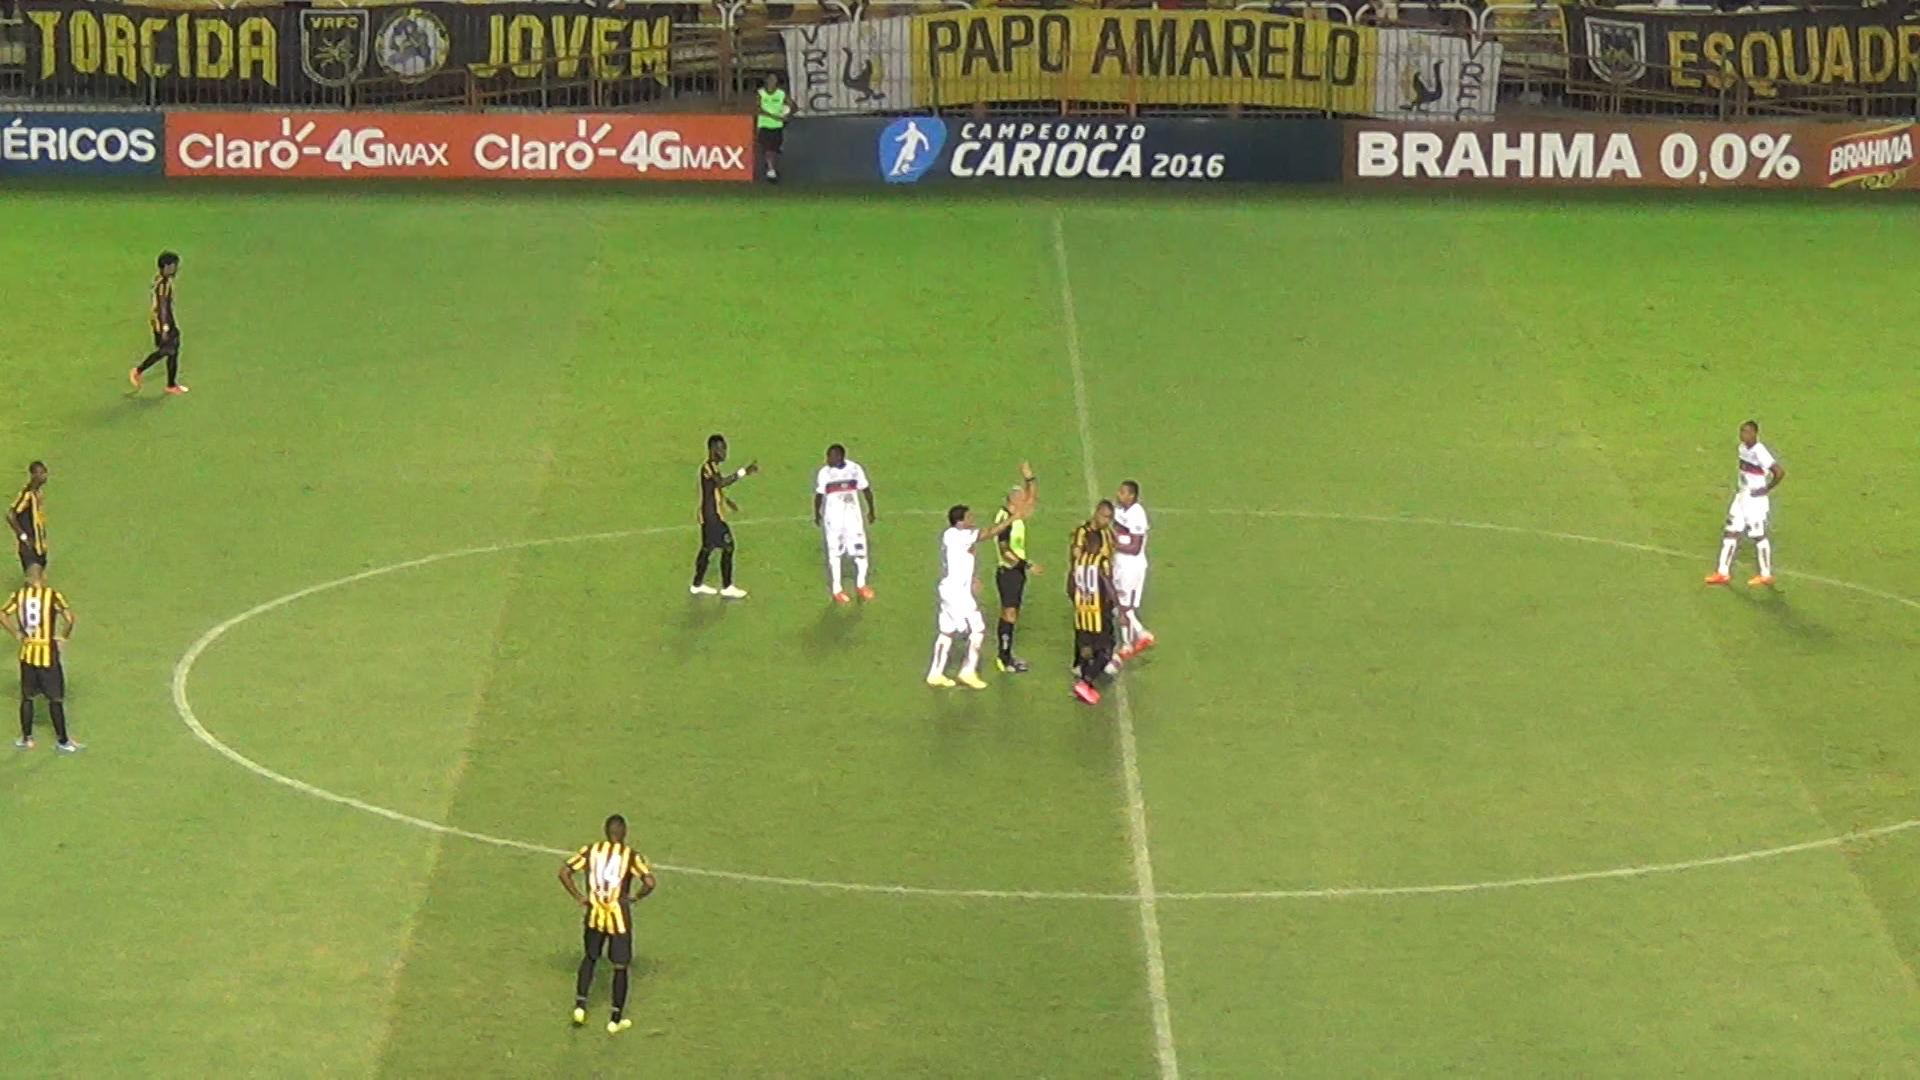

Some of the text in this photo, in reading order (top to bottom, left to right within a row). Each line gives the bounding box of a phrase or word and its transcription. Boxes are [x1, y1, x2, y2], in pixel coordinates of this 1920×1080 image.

[310, 16, 358, 29] VRFC
[27, 10, 670, 88] TORCIDA JOVEM
[927, 14, 1359, 86] PAPO AMARELO
[3, 117, 157, 163] ÉRICOS
[179, 127, 302, 169] Claro
[474, 128, 598, 171] Claro
[960, 122, 1147, 141] CAMPEONATO
[950, 142, 1226, 178] CARIOCA 2016
[1357, 131, 1800, 185] BRAHMA 0,0%
[1828, 132, 1914, 176] BRAHMA
